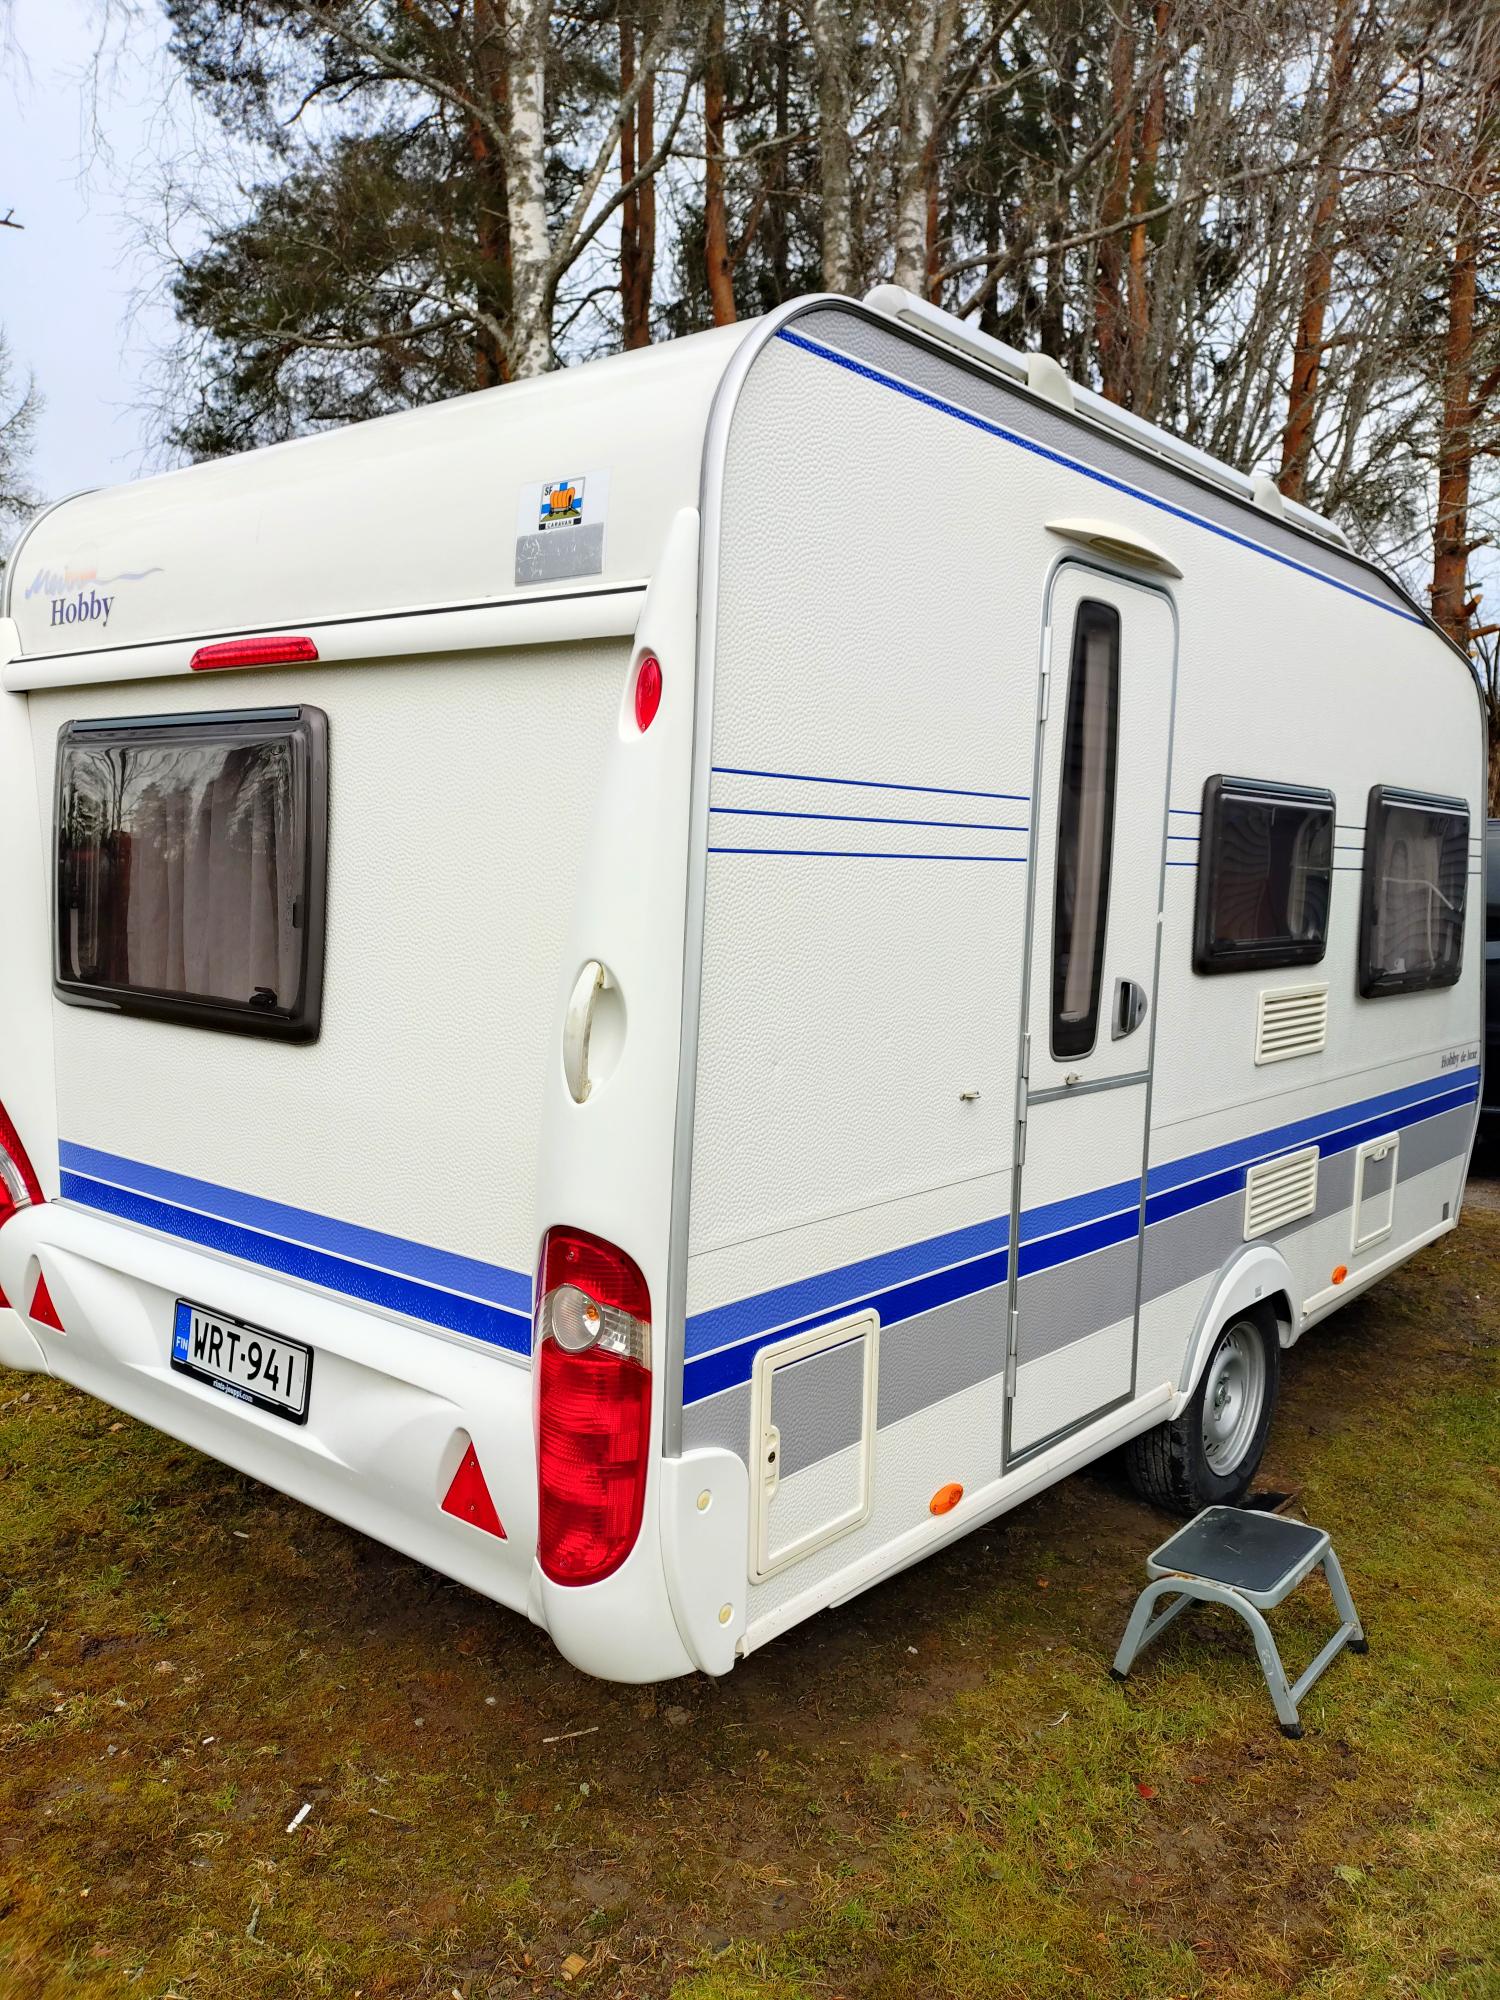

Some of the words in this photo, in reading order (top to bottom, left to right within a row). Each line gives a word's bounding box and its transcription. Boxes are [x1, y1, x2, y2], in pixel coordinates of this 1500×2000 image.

[545, 486, 553, 496] SF
[547, 520, 572, 529] CARAVAN
[50, 589, 115, 628] Hobby
[1441, 1051, 1460, 1068] Hobby
[175, 1335, 189, 1351] FIN
[194, 1317, 294, 1397] WRT-941
